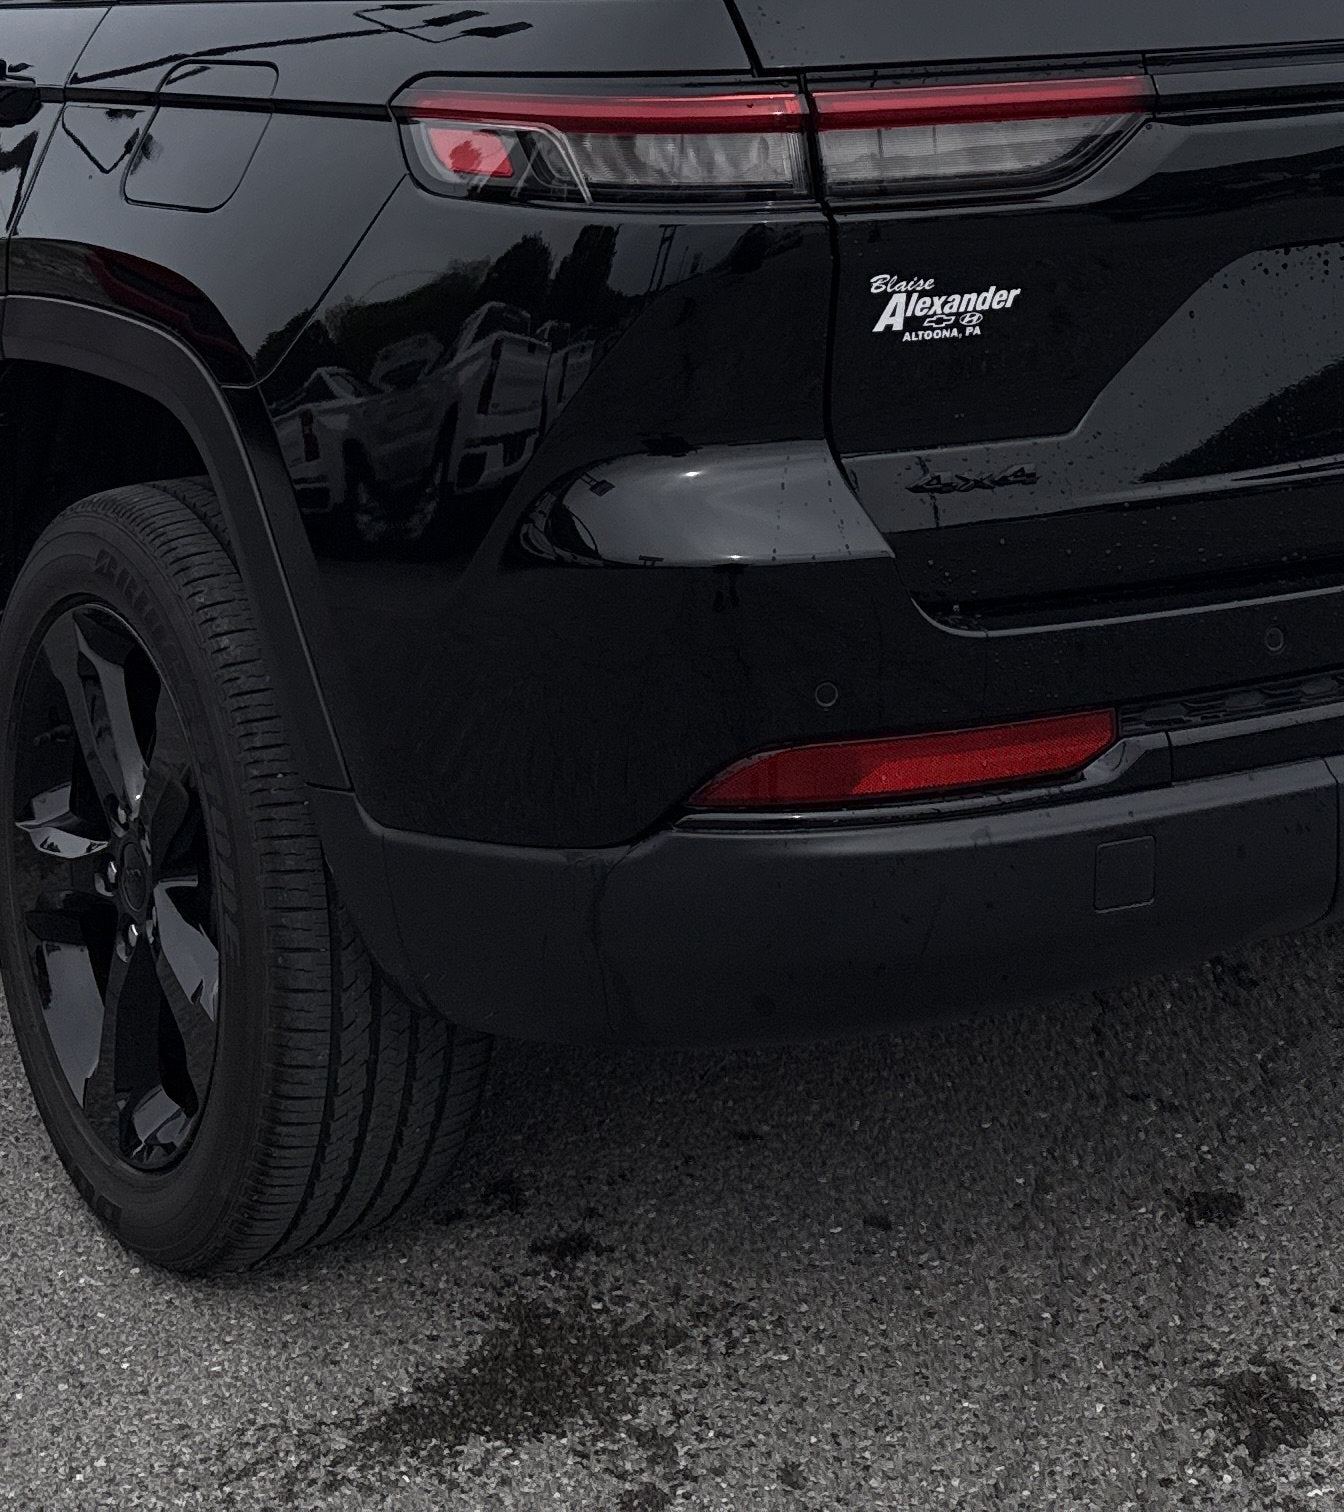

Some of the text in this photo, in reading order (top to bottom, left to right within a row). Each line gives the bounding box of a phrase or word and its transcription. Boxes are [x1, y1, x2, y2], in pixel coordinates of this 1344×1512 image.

[870, 274, 935, 293] Blaise
[872, 285, 1021, 332] Alexander
[902, 326, 981, 342] ALTOONA, PA
